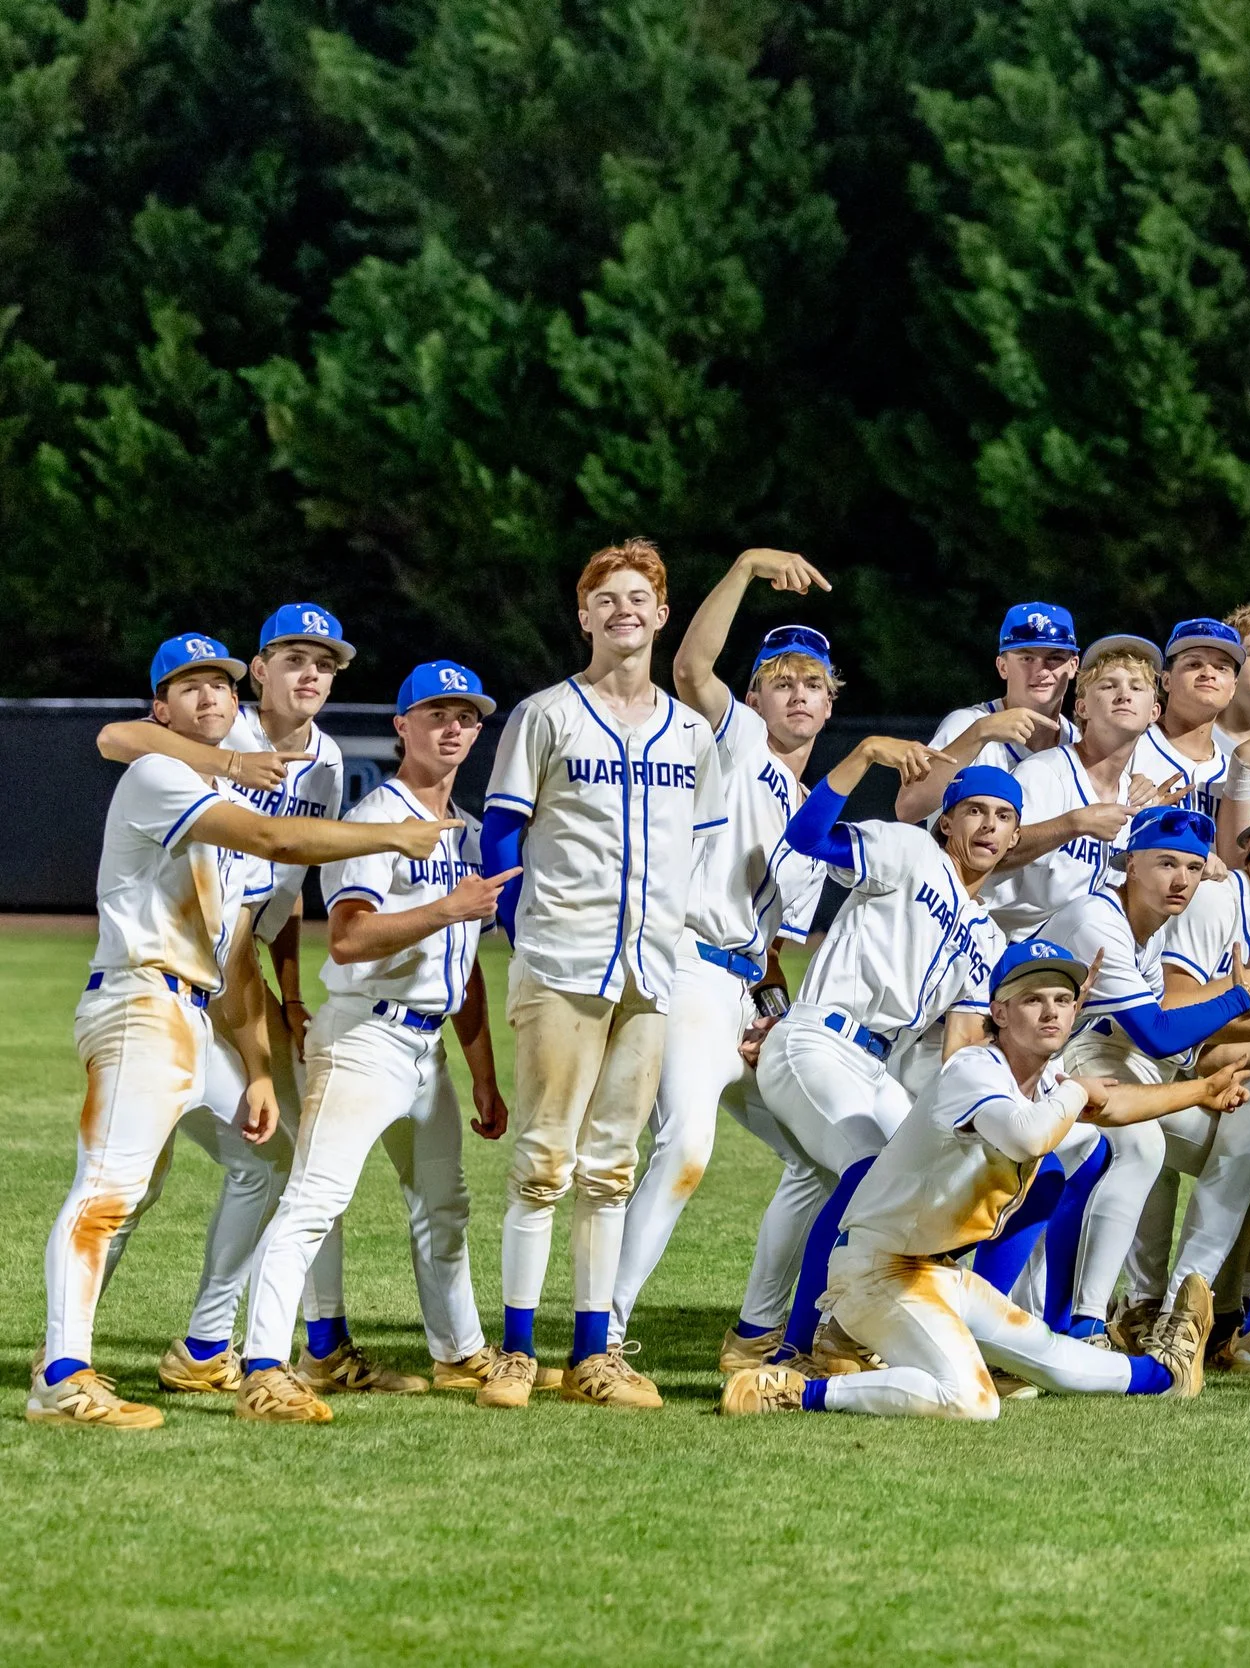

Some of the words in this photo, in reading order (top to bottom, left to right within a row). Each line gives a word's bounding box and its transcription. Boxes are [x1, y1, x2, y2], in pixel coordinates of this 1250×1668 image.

[302, 611, 330, 635] OC
[185, 638, 216, 661] OC
[439, 668, 468, 691] OC
[564, 759, 696, 789] WARRIORS
